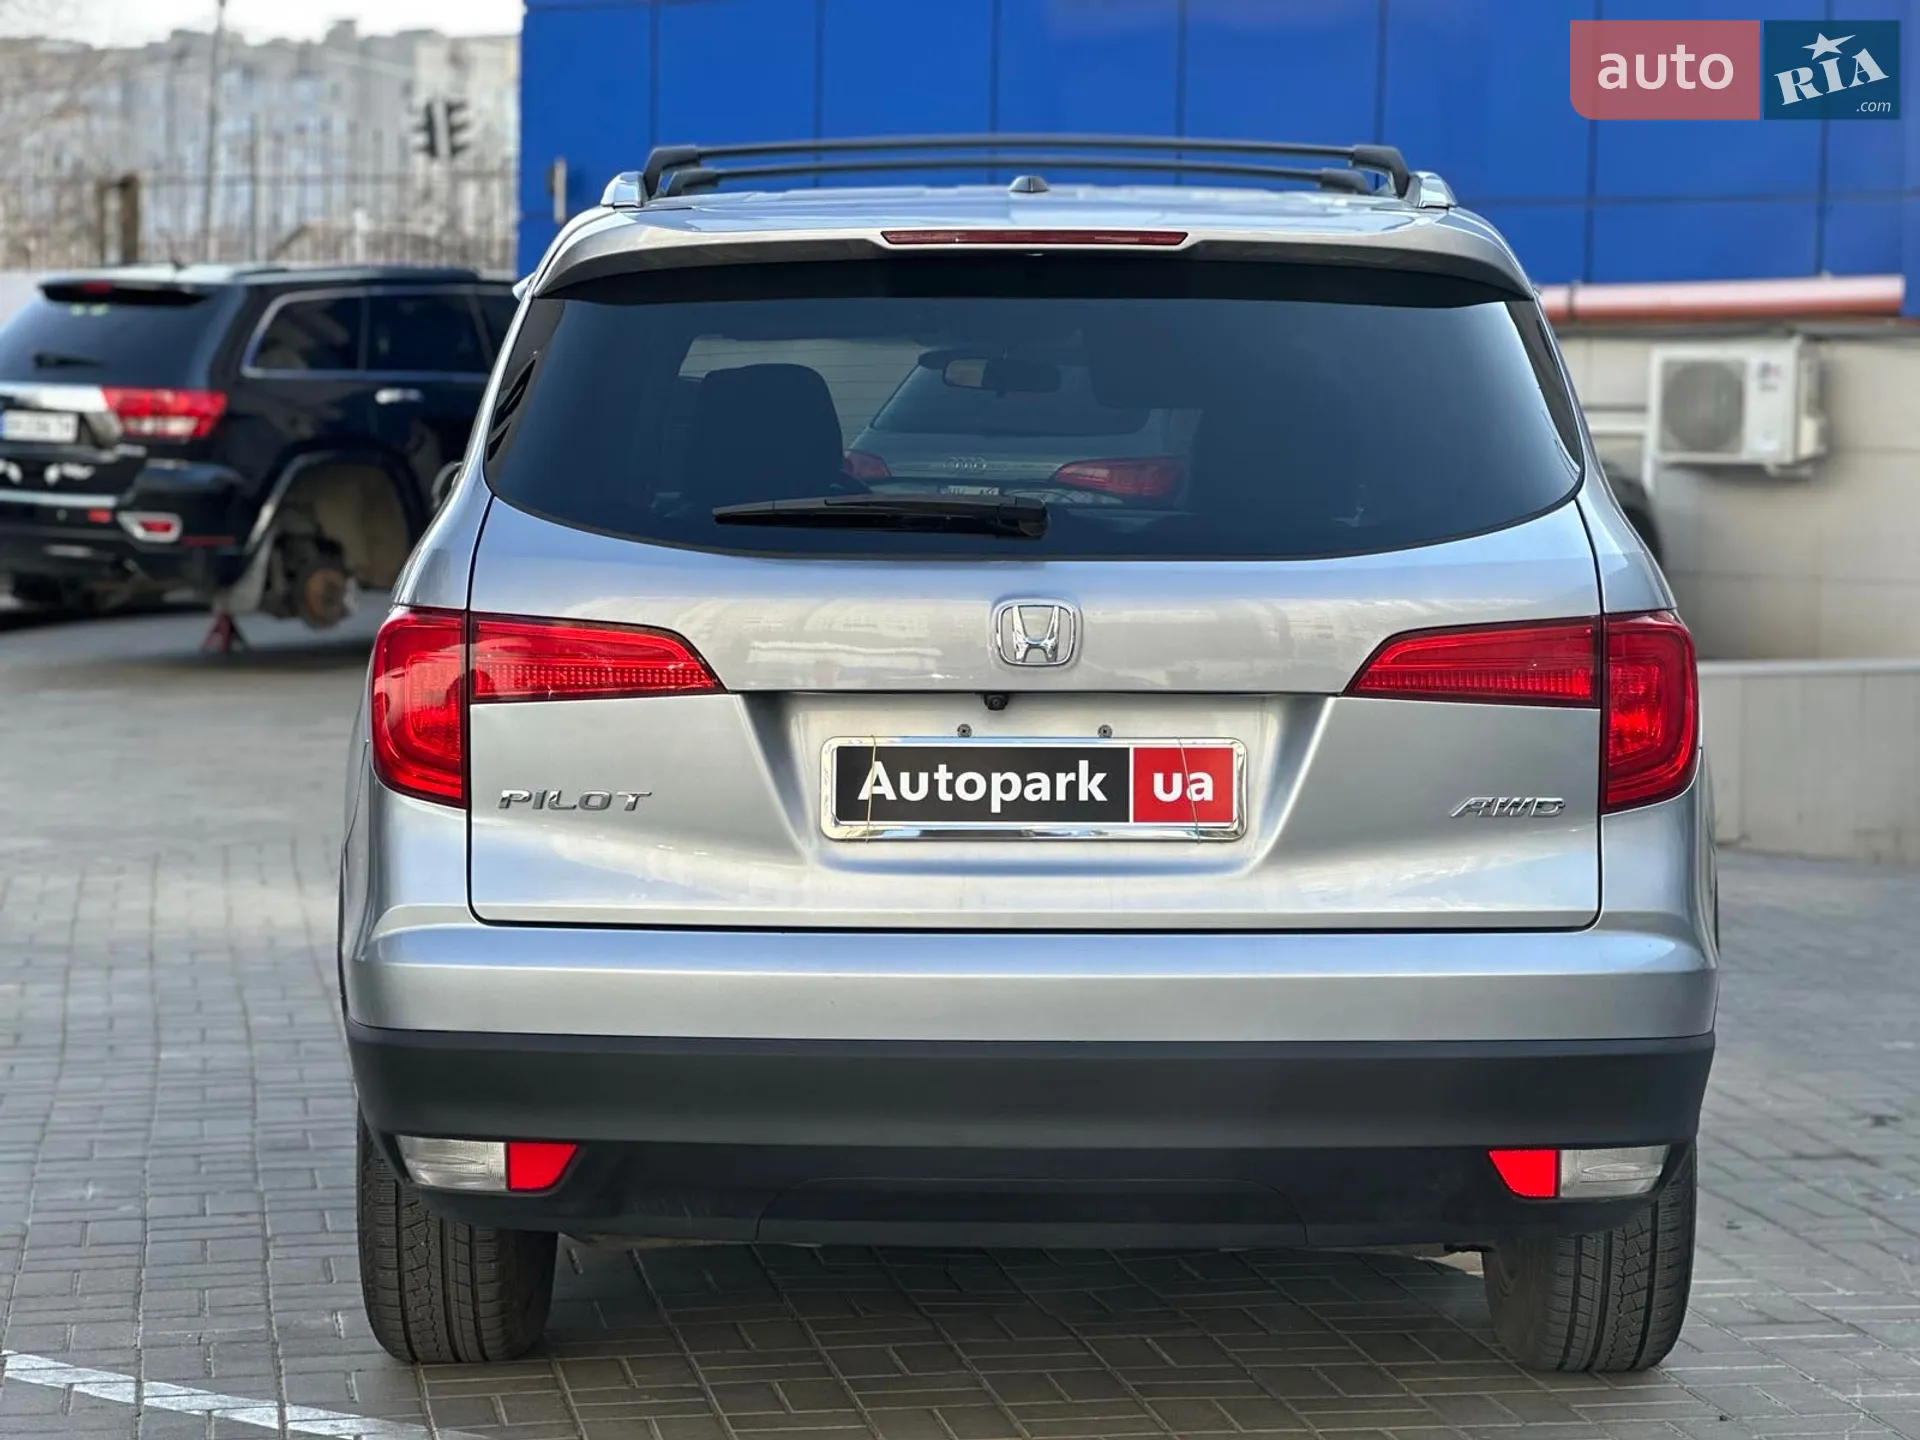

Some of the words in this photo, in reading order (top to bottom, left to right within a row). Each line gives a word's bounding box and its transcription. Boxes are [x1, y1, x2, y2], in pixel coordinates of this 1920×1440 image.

[857, 759, 1108, 813] Autopark
[1152, 772, 1214, 802] ua
[498, 789, 652, 812] PILOT
[1449, 796, 1565, 818] AWD
